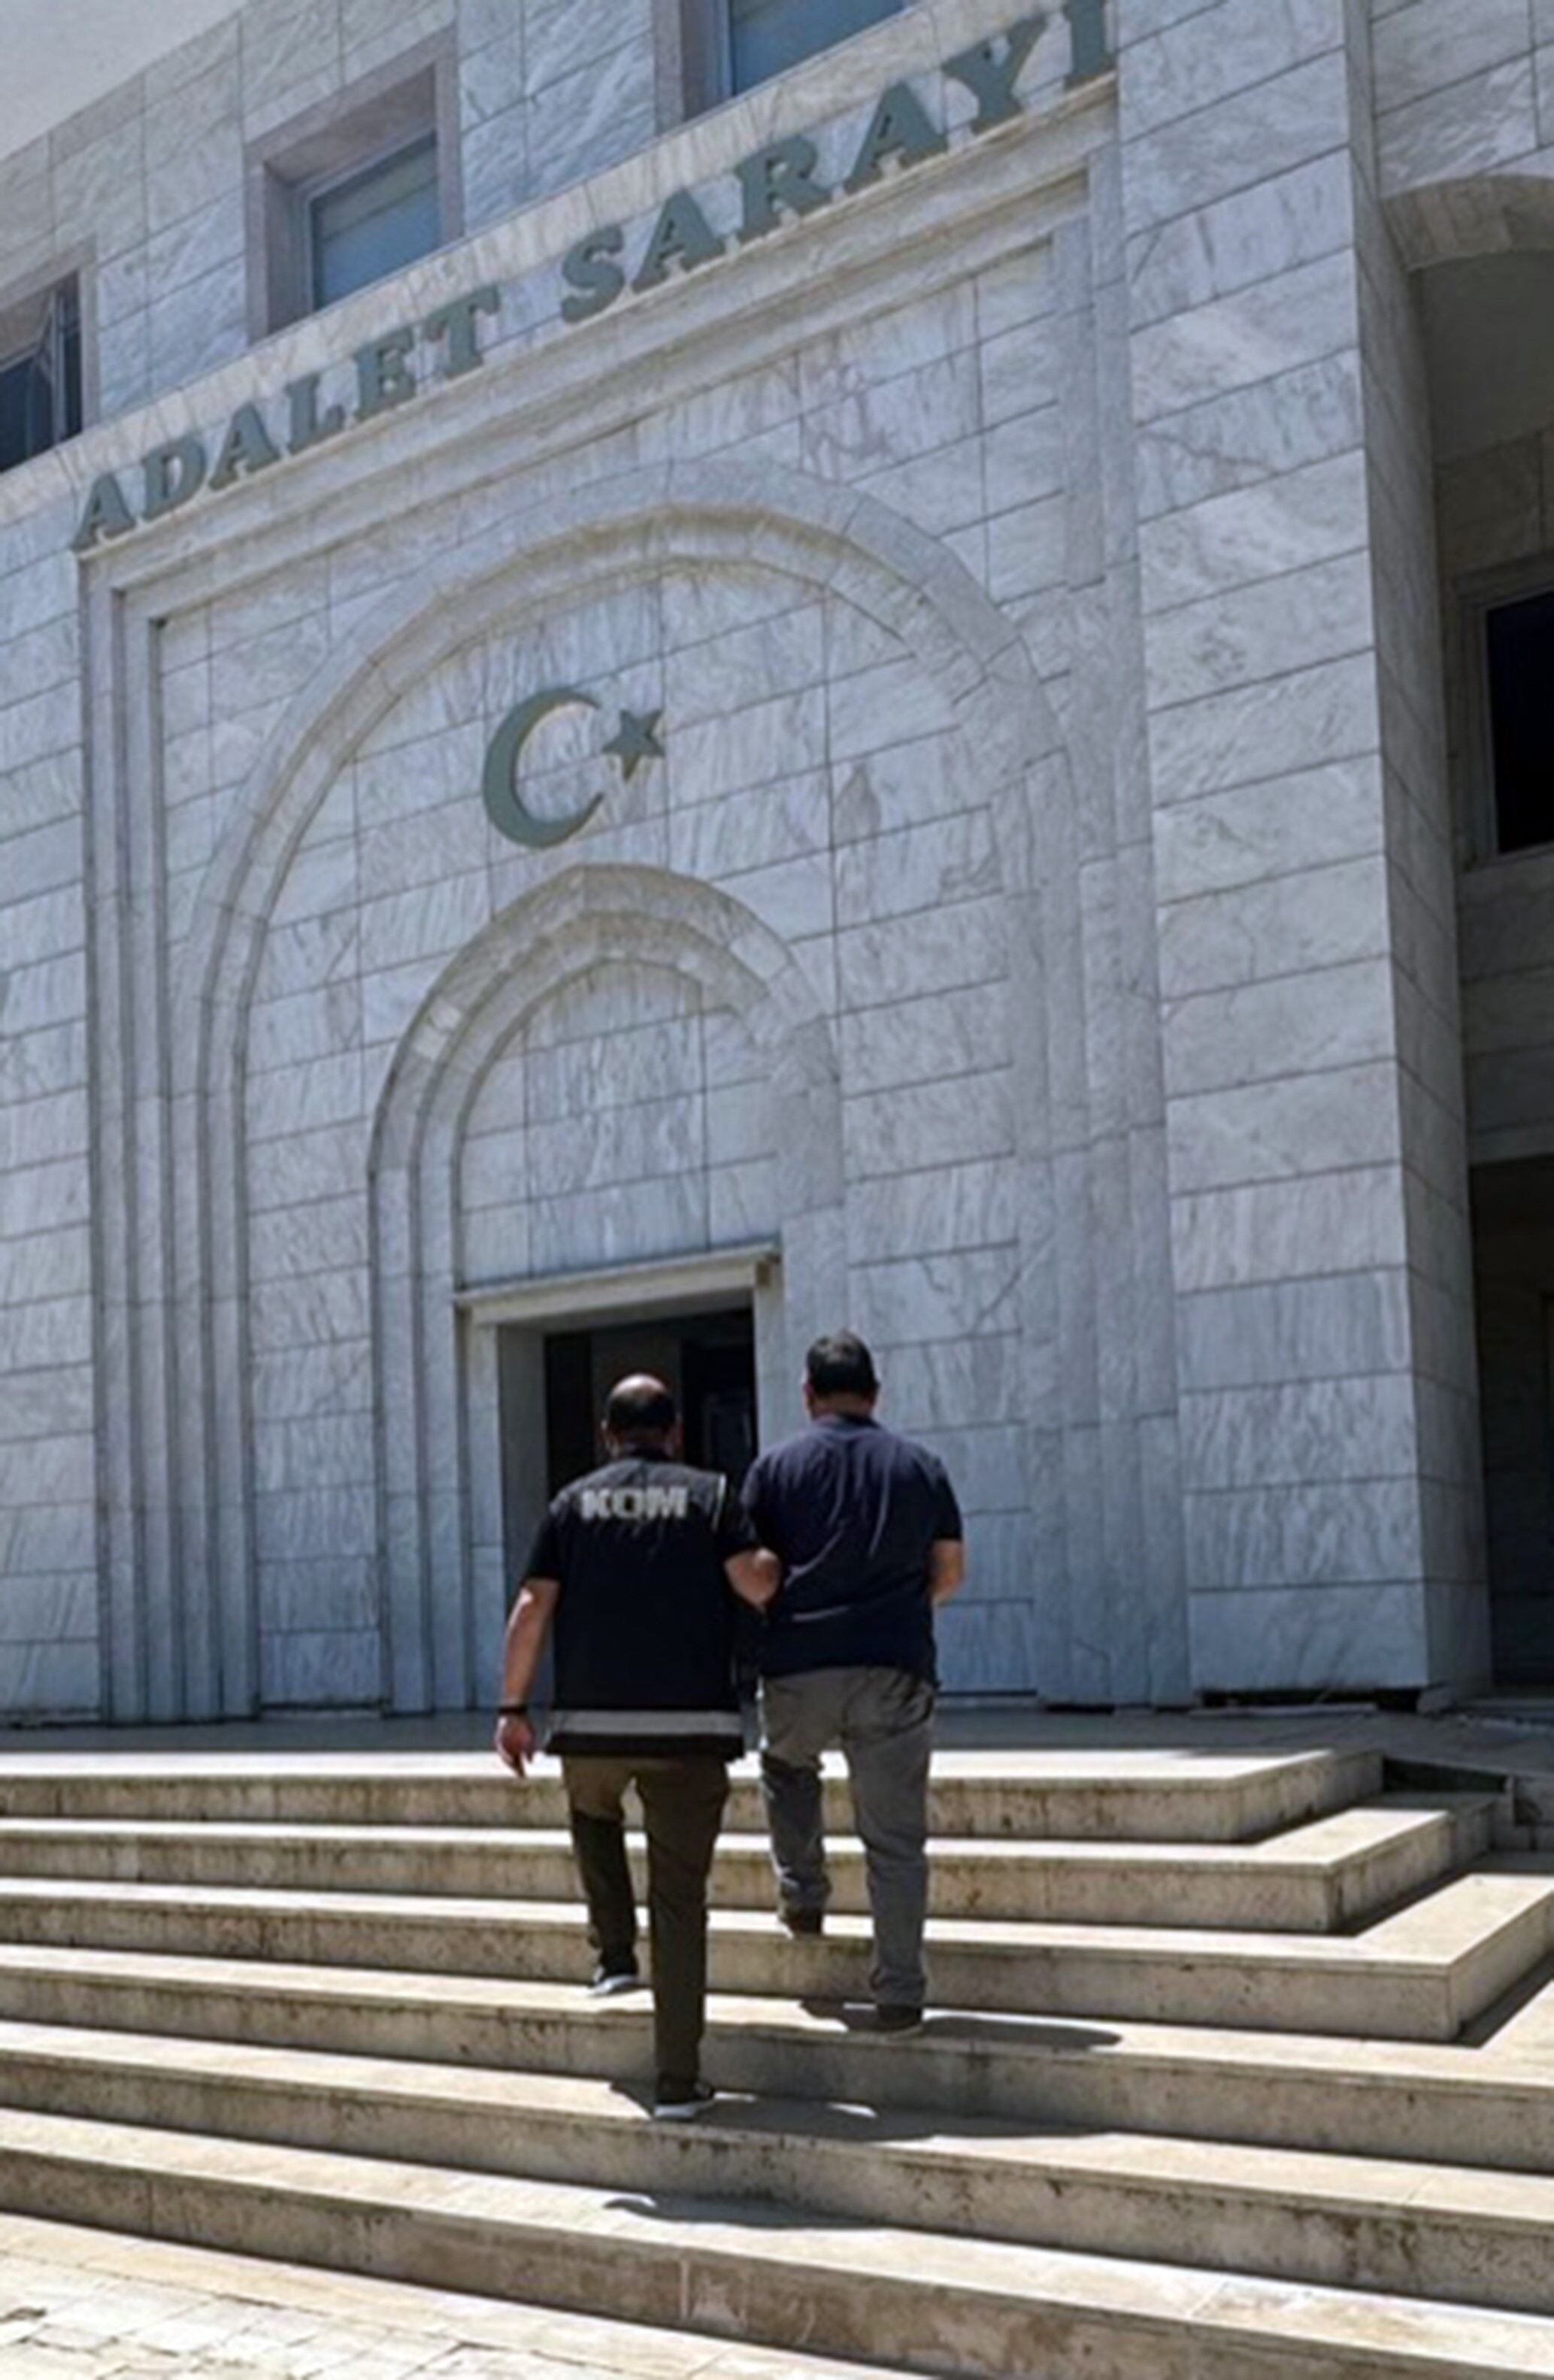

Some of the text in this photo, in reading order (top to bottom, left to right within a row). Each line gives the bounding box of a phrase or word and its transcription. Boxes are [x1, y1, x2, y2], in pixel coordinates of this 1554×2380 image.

[74, 0, 1117, 551] ADALET SARAYI
[581, 1486, 688, 1520] KOM
